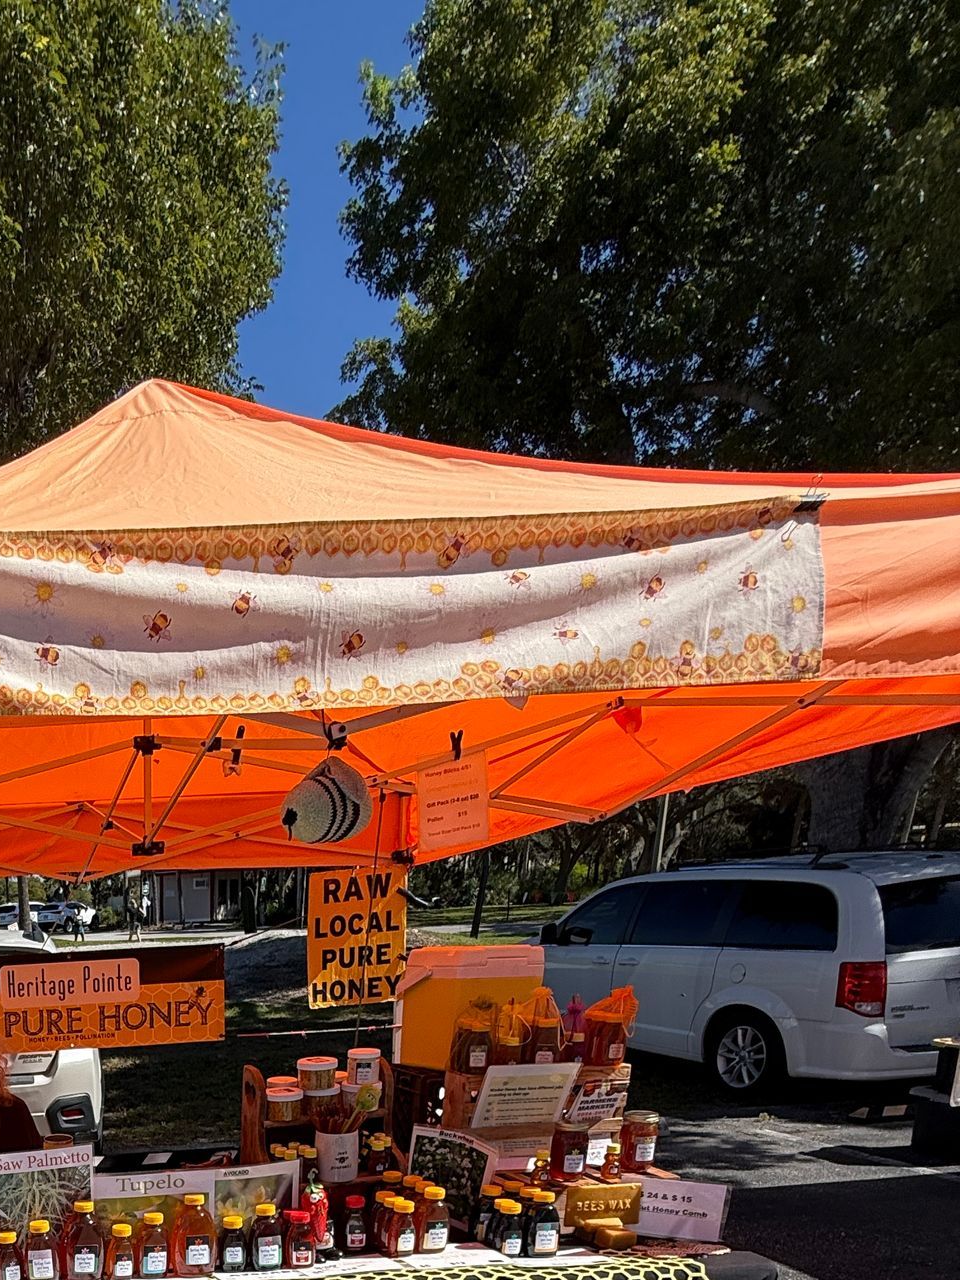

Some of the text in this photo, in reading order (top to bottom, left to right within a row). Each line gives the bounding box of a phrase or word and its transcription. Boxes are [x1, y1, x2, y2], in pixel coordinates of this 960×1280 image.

[323, 873, 392, 904] RAW
[315, 910, 399, 939] LOCAL
[322, 943, 391, 970] PURE
[7, 964, 133, 1001] Heritage Pointe
[312, 974, 402, 1003] HONEY
[4, 998, 216, 1038] PURE HONEY
[578, 1103, 615, 1111] MARKETS
[580, 1097, 618, 1105] FARMERS
[27, 1151, 90, 1169] Palmetto
[223, 1169, 250, 1177] AVOCADO
[116, 1174, 186, 1194] Tupelo
[608, 1199, 632, 1210] WAX
[661, 1193, 668, 1201] &
[640, 1204, 708, 1218] ut Honey Comb
